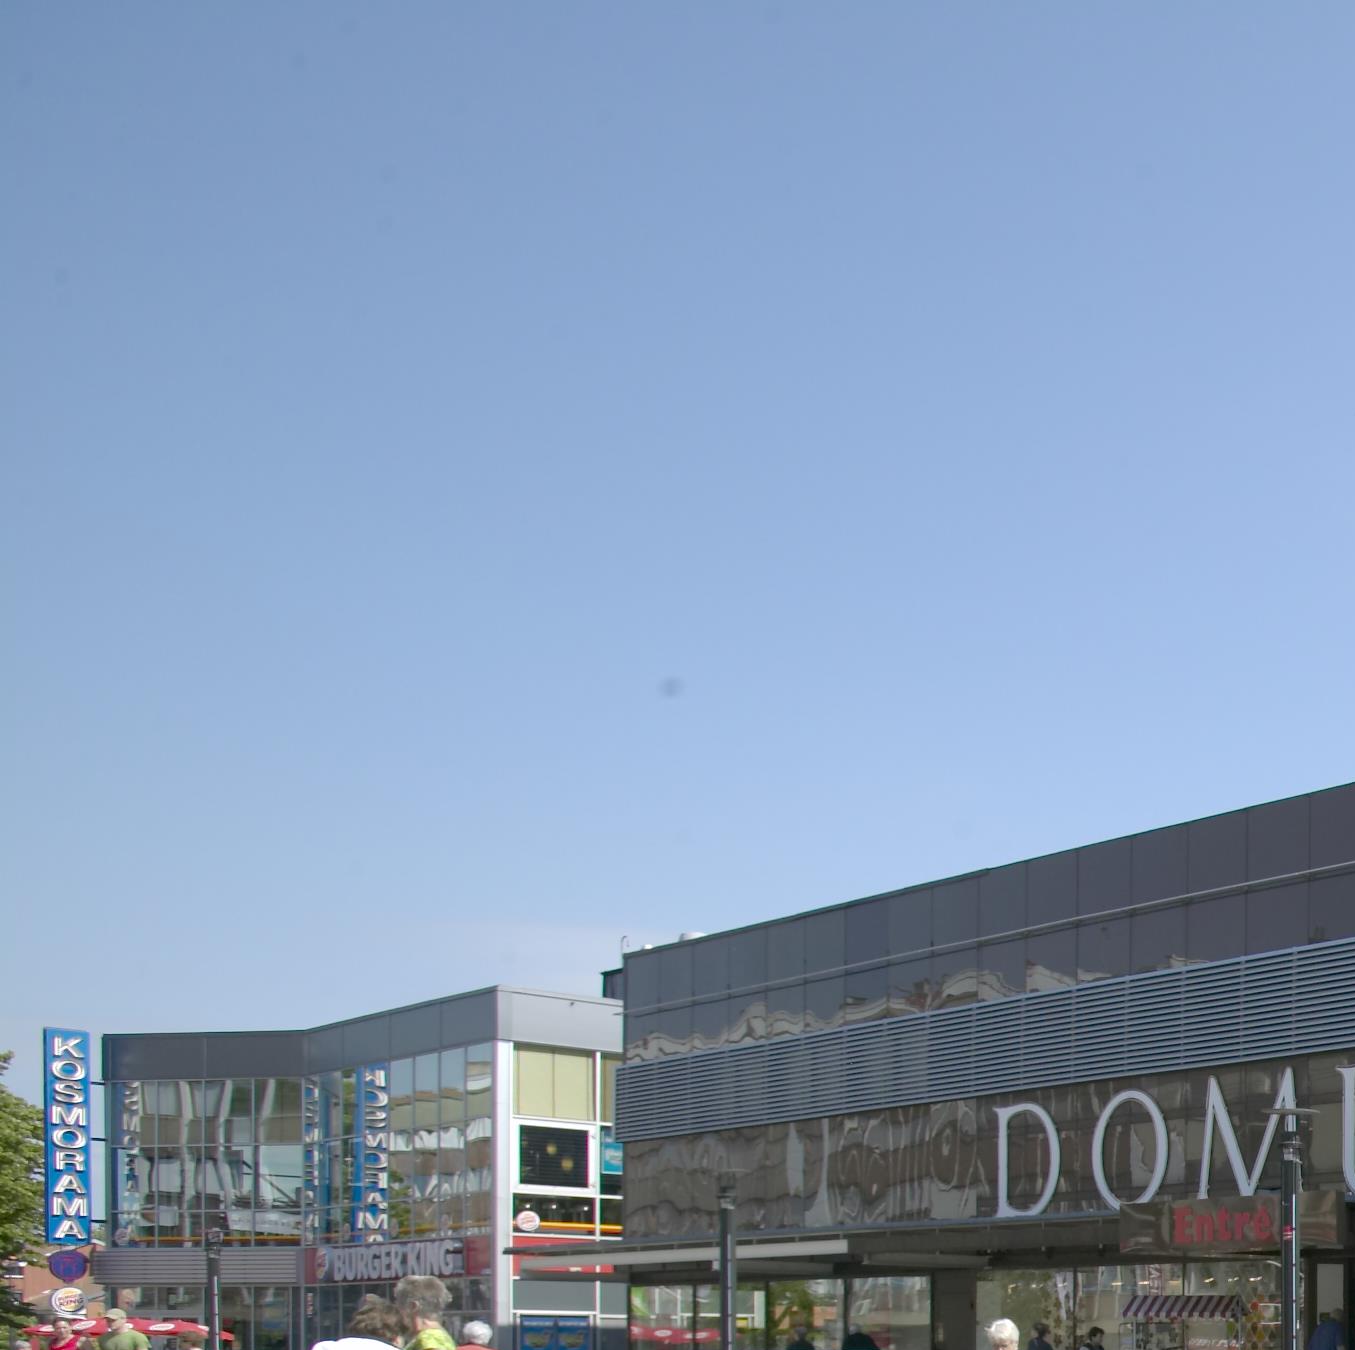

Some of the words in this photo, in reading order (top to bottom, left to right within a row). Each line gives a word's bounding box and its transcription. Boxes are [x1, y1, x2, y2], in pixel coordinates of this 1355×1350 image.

[51, 1035, 88, 1240] KOSMORAMA
[1172, 1204, 1271, 1245] Entré
[333, 1245, 402, 1281] BURGER
[406, 1239, 455, 1277] KING
